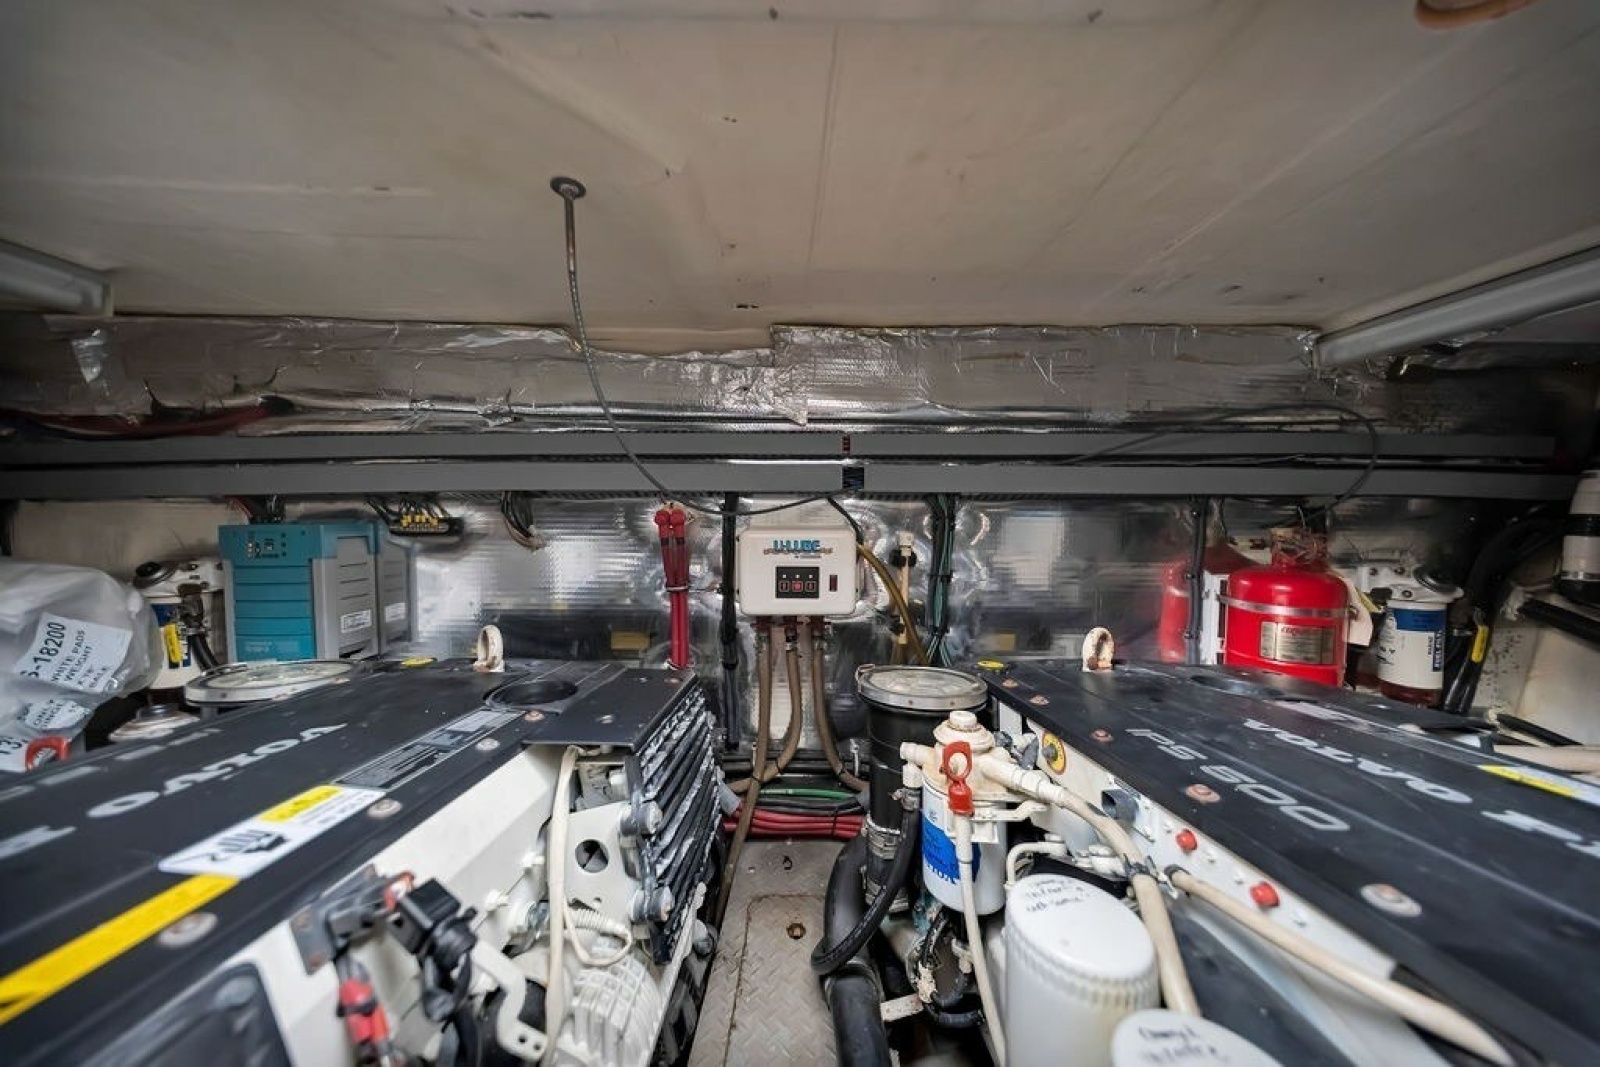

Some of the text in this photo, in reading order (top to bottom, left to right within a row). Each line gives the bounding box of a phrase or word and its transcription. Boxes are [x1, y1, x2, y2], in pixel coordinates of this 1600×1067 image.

[87, 723, 347, 817] VOLVO
[1200, 764, 1349, 831] 500
[1243, 718, 1473, 803] VOLVO
